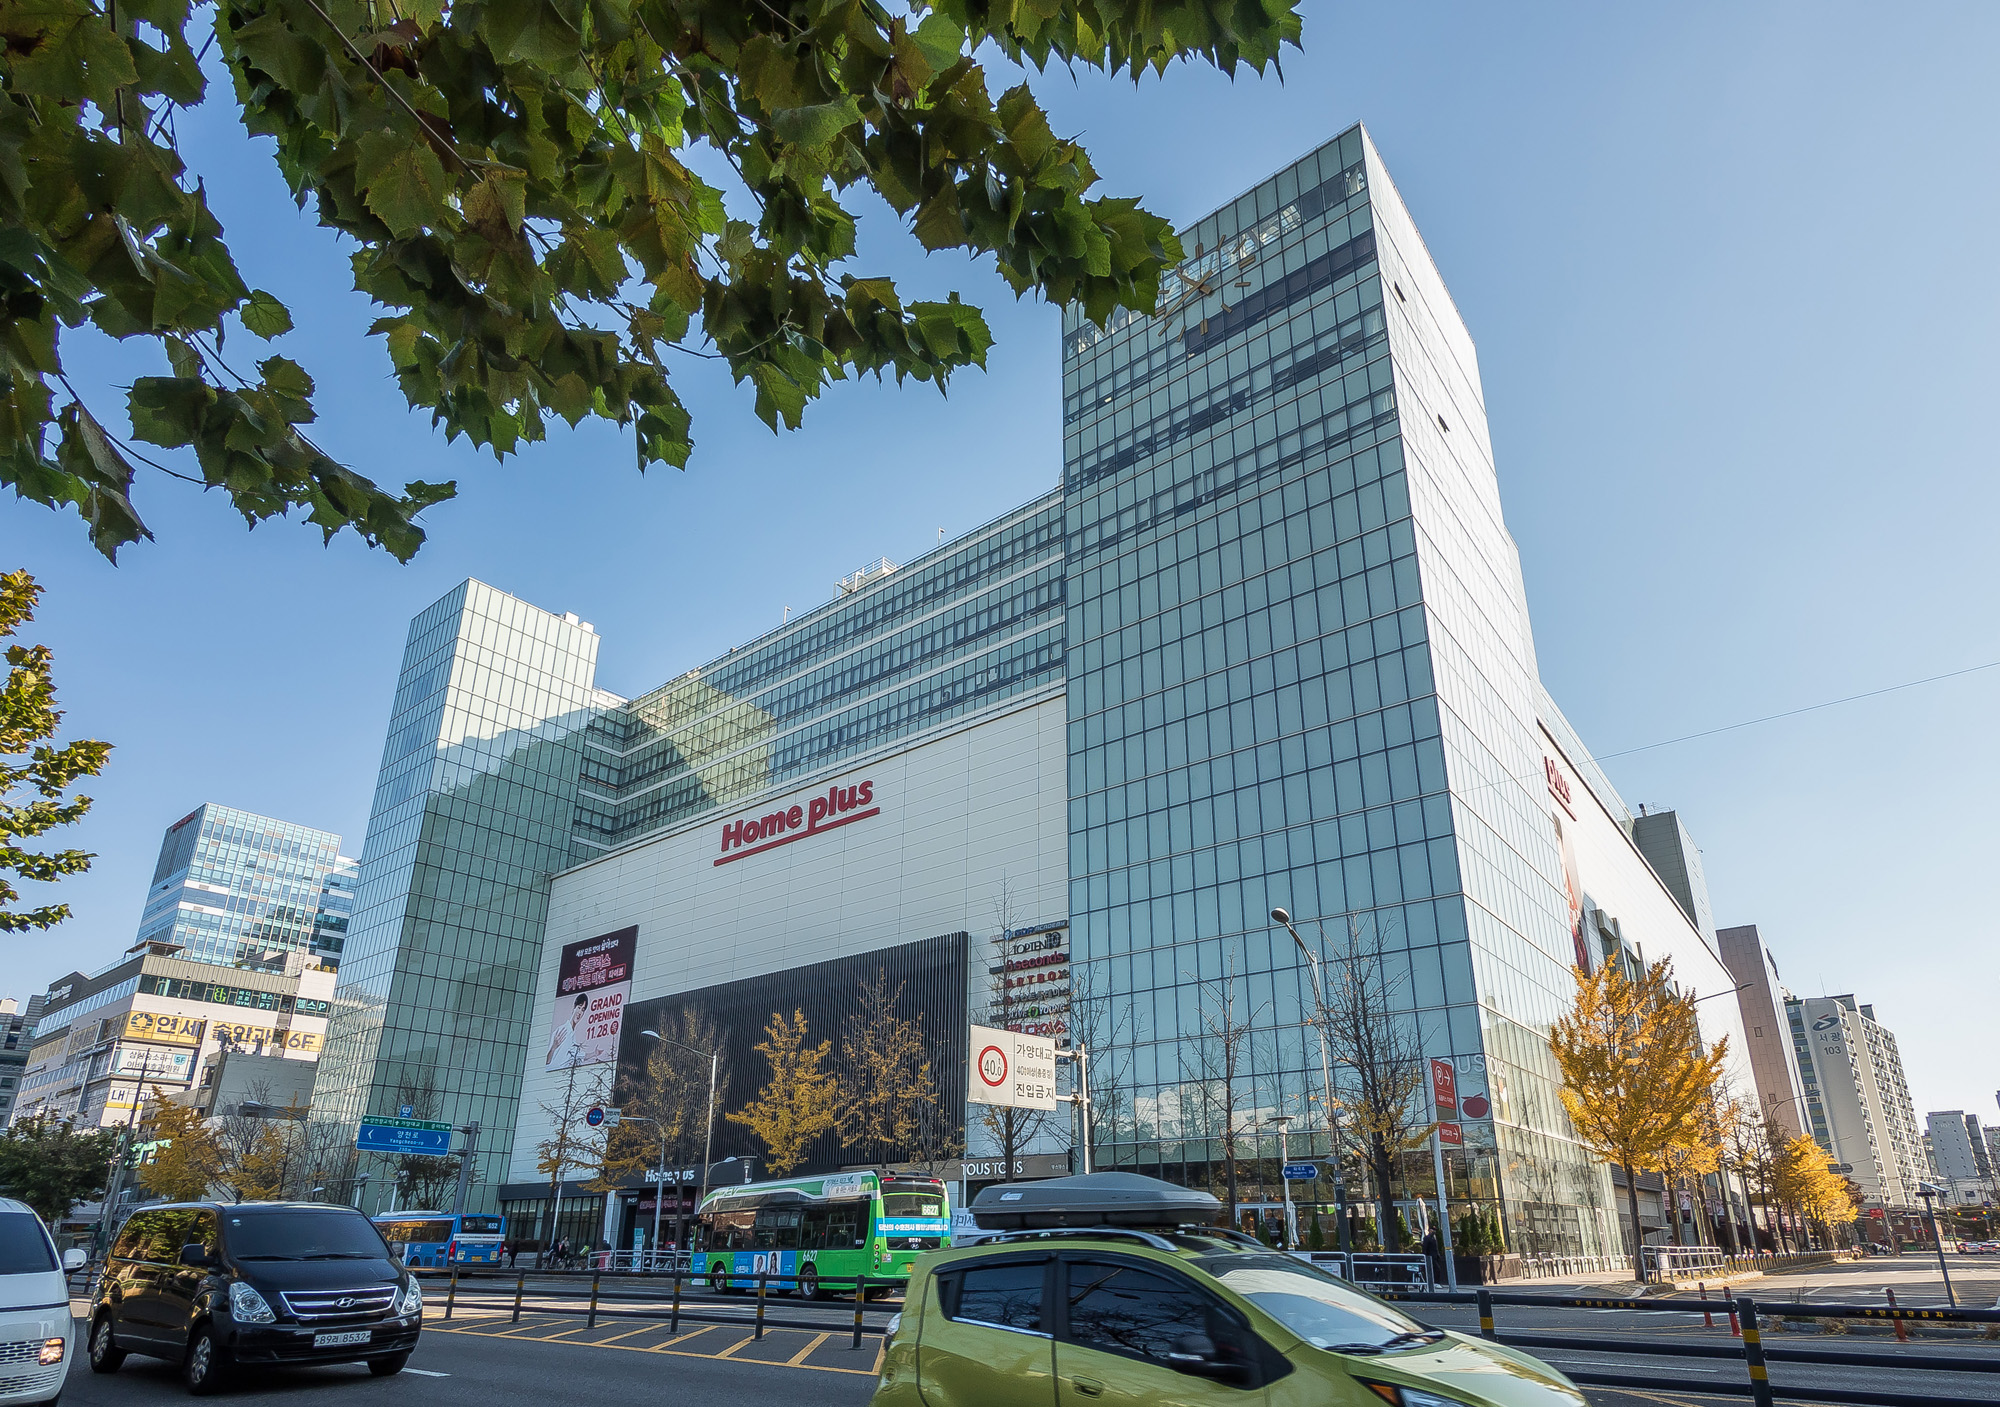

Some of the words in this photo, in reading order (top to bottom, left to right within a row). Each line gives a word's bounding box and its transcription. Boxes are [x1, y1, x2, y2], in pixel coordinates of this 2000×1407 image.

[720, 805, 803, 852] Home
[807, 780, 874, 832] plus
[580, 953, 612, 975] 홈플러스
[562, 975, 577, 992] 메가
[577, 973, 592, 989] 푸드
[591, 968, 607, 985] 마켓
[608, 966, 625, 979] 라이브
[1006, 969, 1064, 989] ARTBOX
[590, 993, 623, 1012] GRAND
[588, 1008, 620, 1024] OPENING
[157, 1017, 197, 1036] 연세
[586, 1023, 609, 1040] 11.28.
[288, 1034, 316, 1048] 6F
[1819, 1031, 1841, 1042] 서광
[1016, 1043, 1053, 1061] 가양대교
[1824, 1045, 1842, 1056] 103
[1016, 1083, 1054, 1100] 진입금지
[397, 1130, 419, 1139] 양천로
[961, 1162, 991, 1176] TOUS
[992, 1160, 1024, 1175] TOS
[672, 1169, 696, 1185] pus
[922, 1205, 938, 1216] 6627
[802, 1250, 818, 1262] 6627
[342, 1332, 367, 1343] 8532
